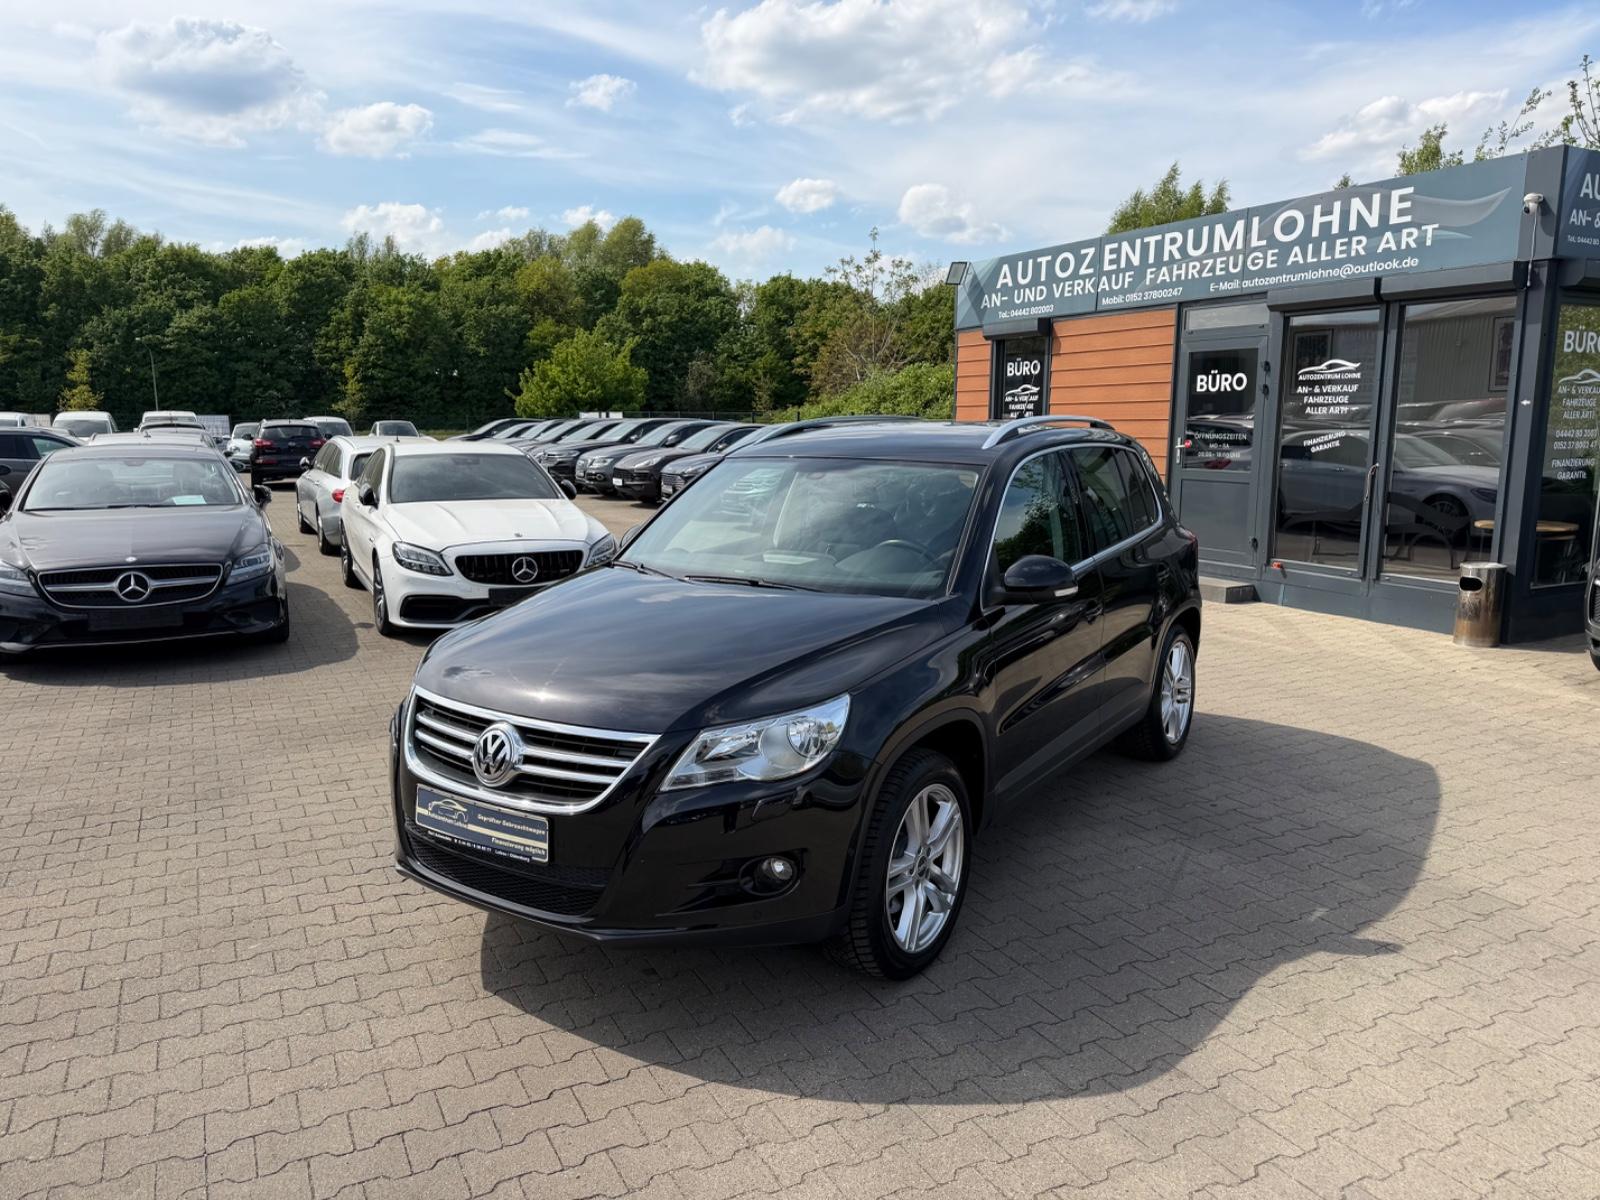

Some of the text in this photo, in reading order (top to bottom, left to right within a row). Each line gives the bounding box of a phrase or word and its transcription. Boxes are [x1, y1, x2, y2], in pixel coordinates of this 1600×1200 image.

[1569, 208, 1592, 227] AN-
[980, 223, 1439, 310] AN- UND VERKAUF FAHRZEUGE ALLER ART
[1242, 256, 1419, 289] autozentrumlohne@outlook.de
[1125, 292, 1143, 303] 0152
[1143, 287, 1183, 300] 37800247
[1563, 325, 1600, 353] BÜR
[1006, 357, 1041, 377] BÜRO
[1196, 369, 1248, 392] BÜRO
[1296, 384, 1360, 394] AN- & VERKAUF
[1303, 395, 1350, 404] FAHRZEUGE
[1305, 406, 1328, 415] ALLER
